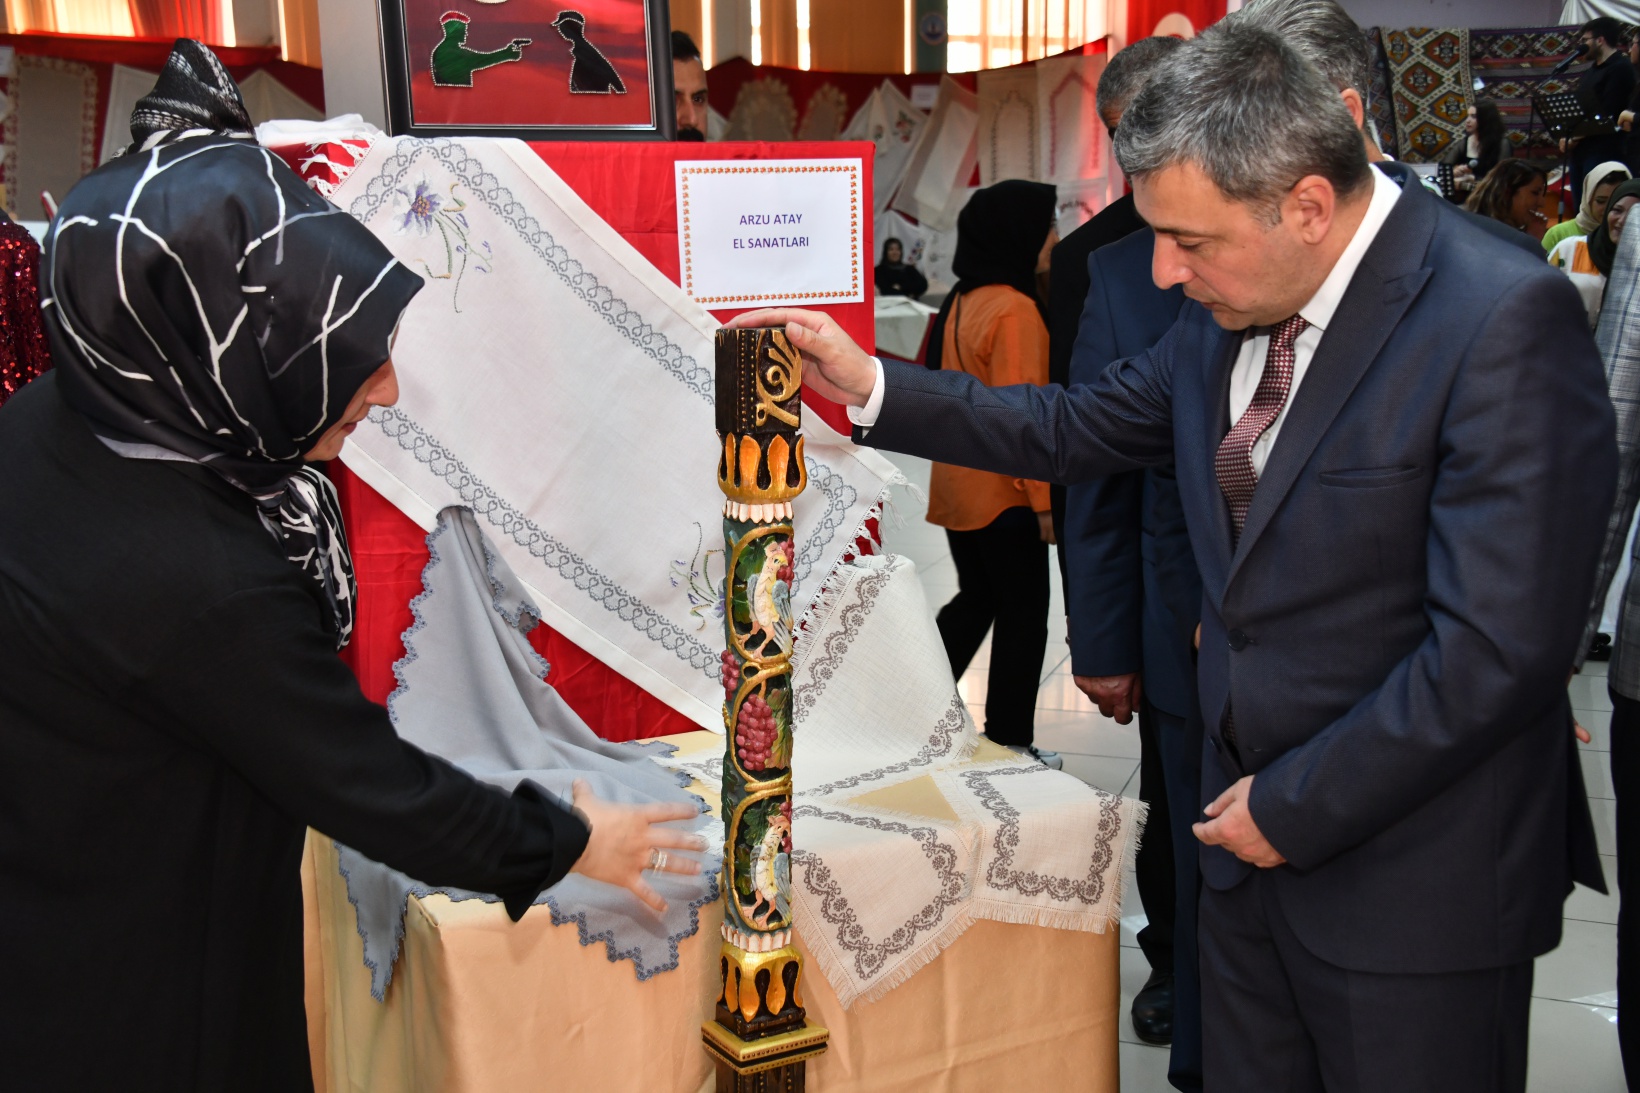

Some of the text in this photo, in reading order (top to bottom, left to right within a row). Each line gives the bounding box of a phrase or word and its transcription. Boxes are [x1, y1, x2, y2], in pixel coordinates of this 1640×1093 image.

[739, 213, 803, 225] ARZU ATAY
[733, 236, 809, 249] EL SANATLARI
